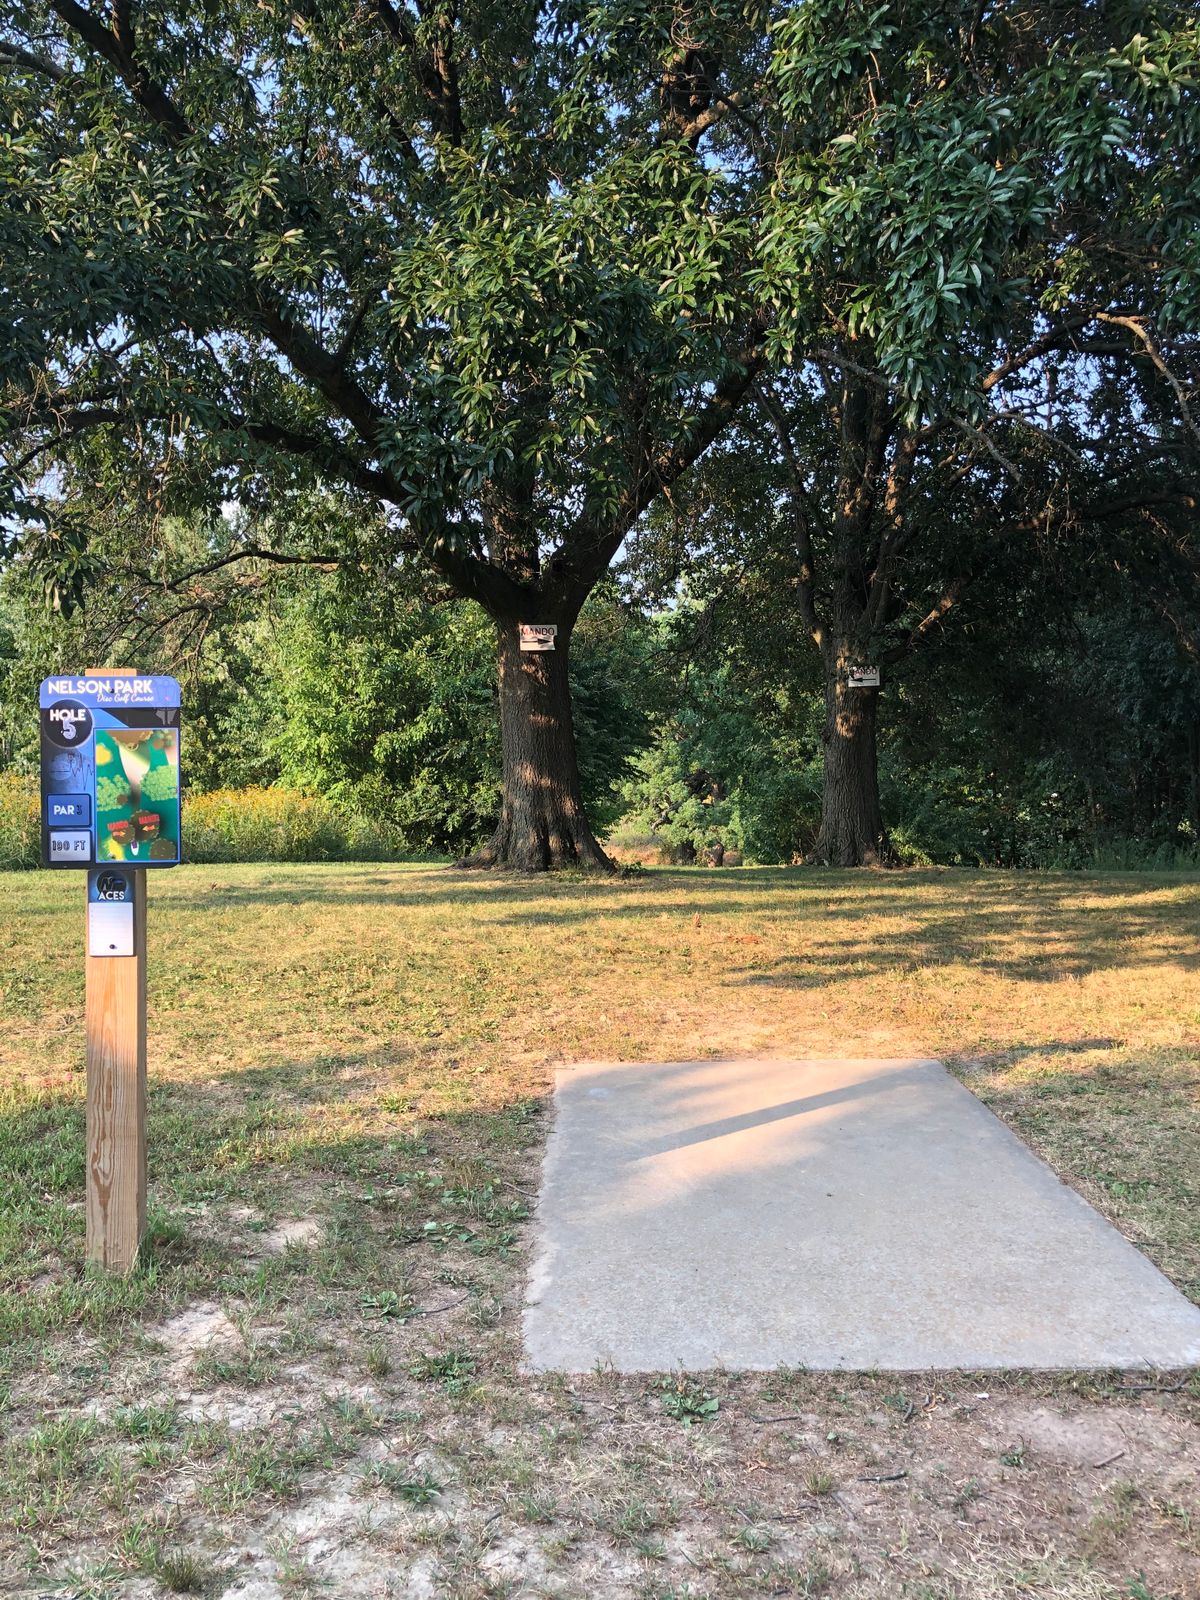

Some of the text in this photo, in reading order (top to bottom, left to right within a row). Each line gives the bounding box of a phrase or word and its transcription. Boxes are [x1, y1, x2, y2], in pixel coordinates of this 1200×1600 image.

[48, 680, 153, 694] NELSON PARK
[96, 693, 154, 704] Disc Golf Course
[50, 709, 86, 722] HOLE
[61, 716, 76, 740] 5
[54, 804, 74, 815] PAR
[74, 840, 86, 851] FT
[98, 890, 124, 900] ACES
